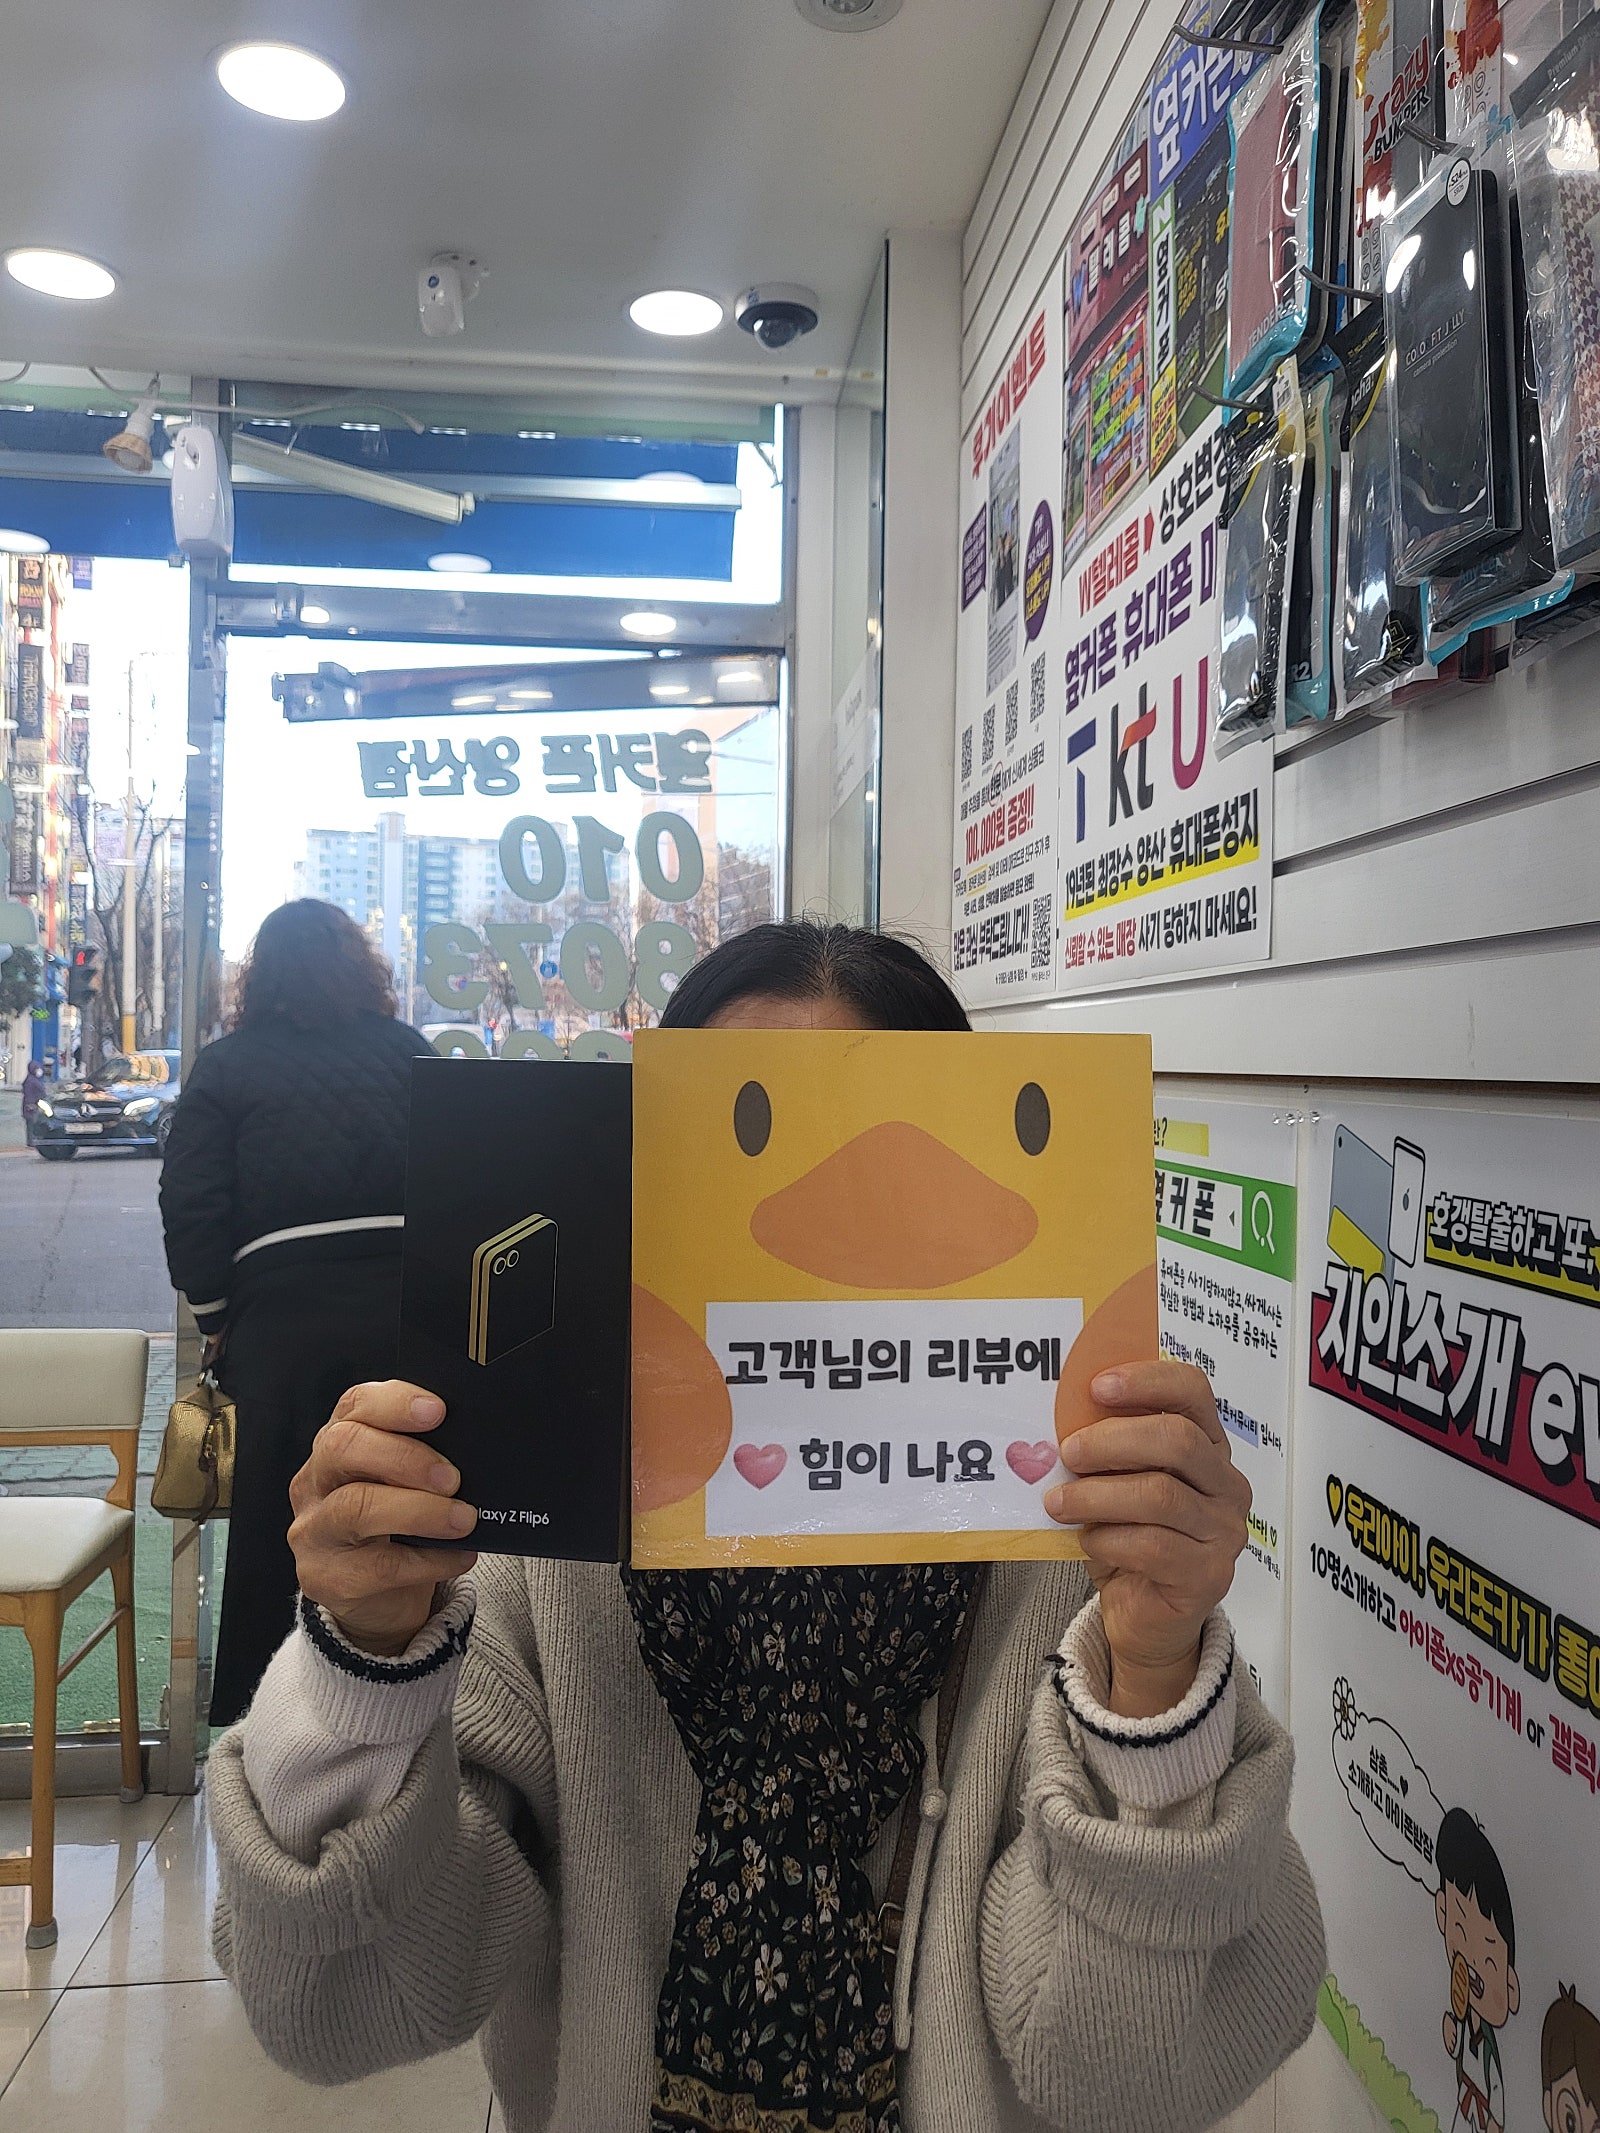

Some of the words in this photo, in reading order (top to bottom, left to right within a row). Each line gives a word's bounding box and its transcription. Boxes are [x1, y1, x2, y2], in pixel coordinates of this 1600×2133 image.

[1122, 541, 1192, 670] 휴대폰
[965, 801, 1005, 866] 100,000원
[1007, 783, 1034, 842] 증정!!
[1066, 858, 1095, 911] 19년된
[1097, 841, 1132, 898] 최장수
[1136, 827, 1165, 887] 양산
[1169, 788, 1258, 875] 휴대폰성지
[1065, 928, 1086, 970] 신뢰할
[1087, 932, 1095, 965] 수
[1097, 924, 1114, 962] 있는
[1116, 917, 1136, 957] 매장
[1138, 909, 1160, 952] 사기
[1163, 898, 1201, 949] 당하지
[1205, 886, 1257, 939] 마세요!
[1429, 1193, 1560, 1264] 호갱탈출하고
[1160, 1258, 1186, 1288] 휴대폰을
[1159, 1283, 1180, 1313] 확실한
[1181, 1294, 1205, 1323] 방법과
[1208, 1306, 1240, 1342] 노하우를
[1243, 1321, 1278, 1359] 공유하는
[1317, 1264, 1522, 1448] 지인소개
[726, 1338, 911, 1390] 고객님의
[928, 1337, 1061, 1385] 리뷰에
[1193, 1347, 1216, 1377] 선택한
[1215, 1396, 1258, 1436] 대폰커뮤니티
[799, 1438, 891, 1491] 힘이
[907, 1439, 996, 1483] 나요
[478, 1507, 507, 1525] laxy
[508, 1510, 517, 1522] Z
[519, 1511, 550, 1528] Flip6
[1346, 1487, 1425, 1594] 우리아이,
[1428, 1542, 1551, 1674] 우리조카가
[1310, 1542, 1397, 1632] 10명소개하고
[1527, 1718, 1545, 1748] or
[1549, 1714, 1600, 1795] 갤럭
[1348, 1759, 1384, 1813] 소개하고
